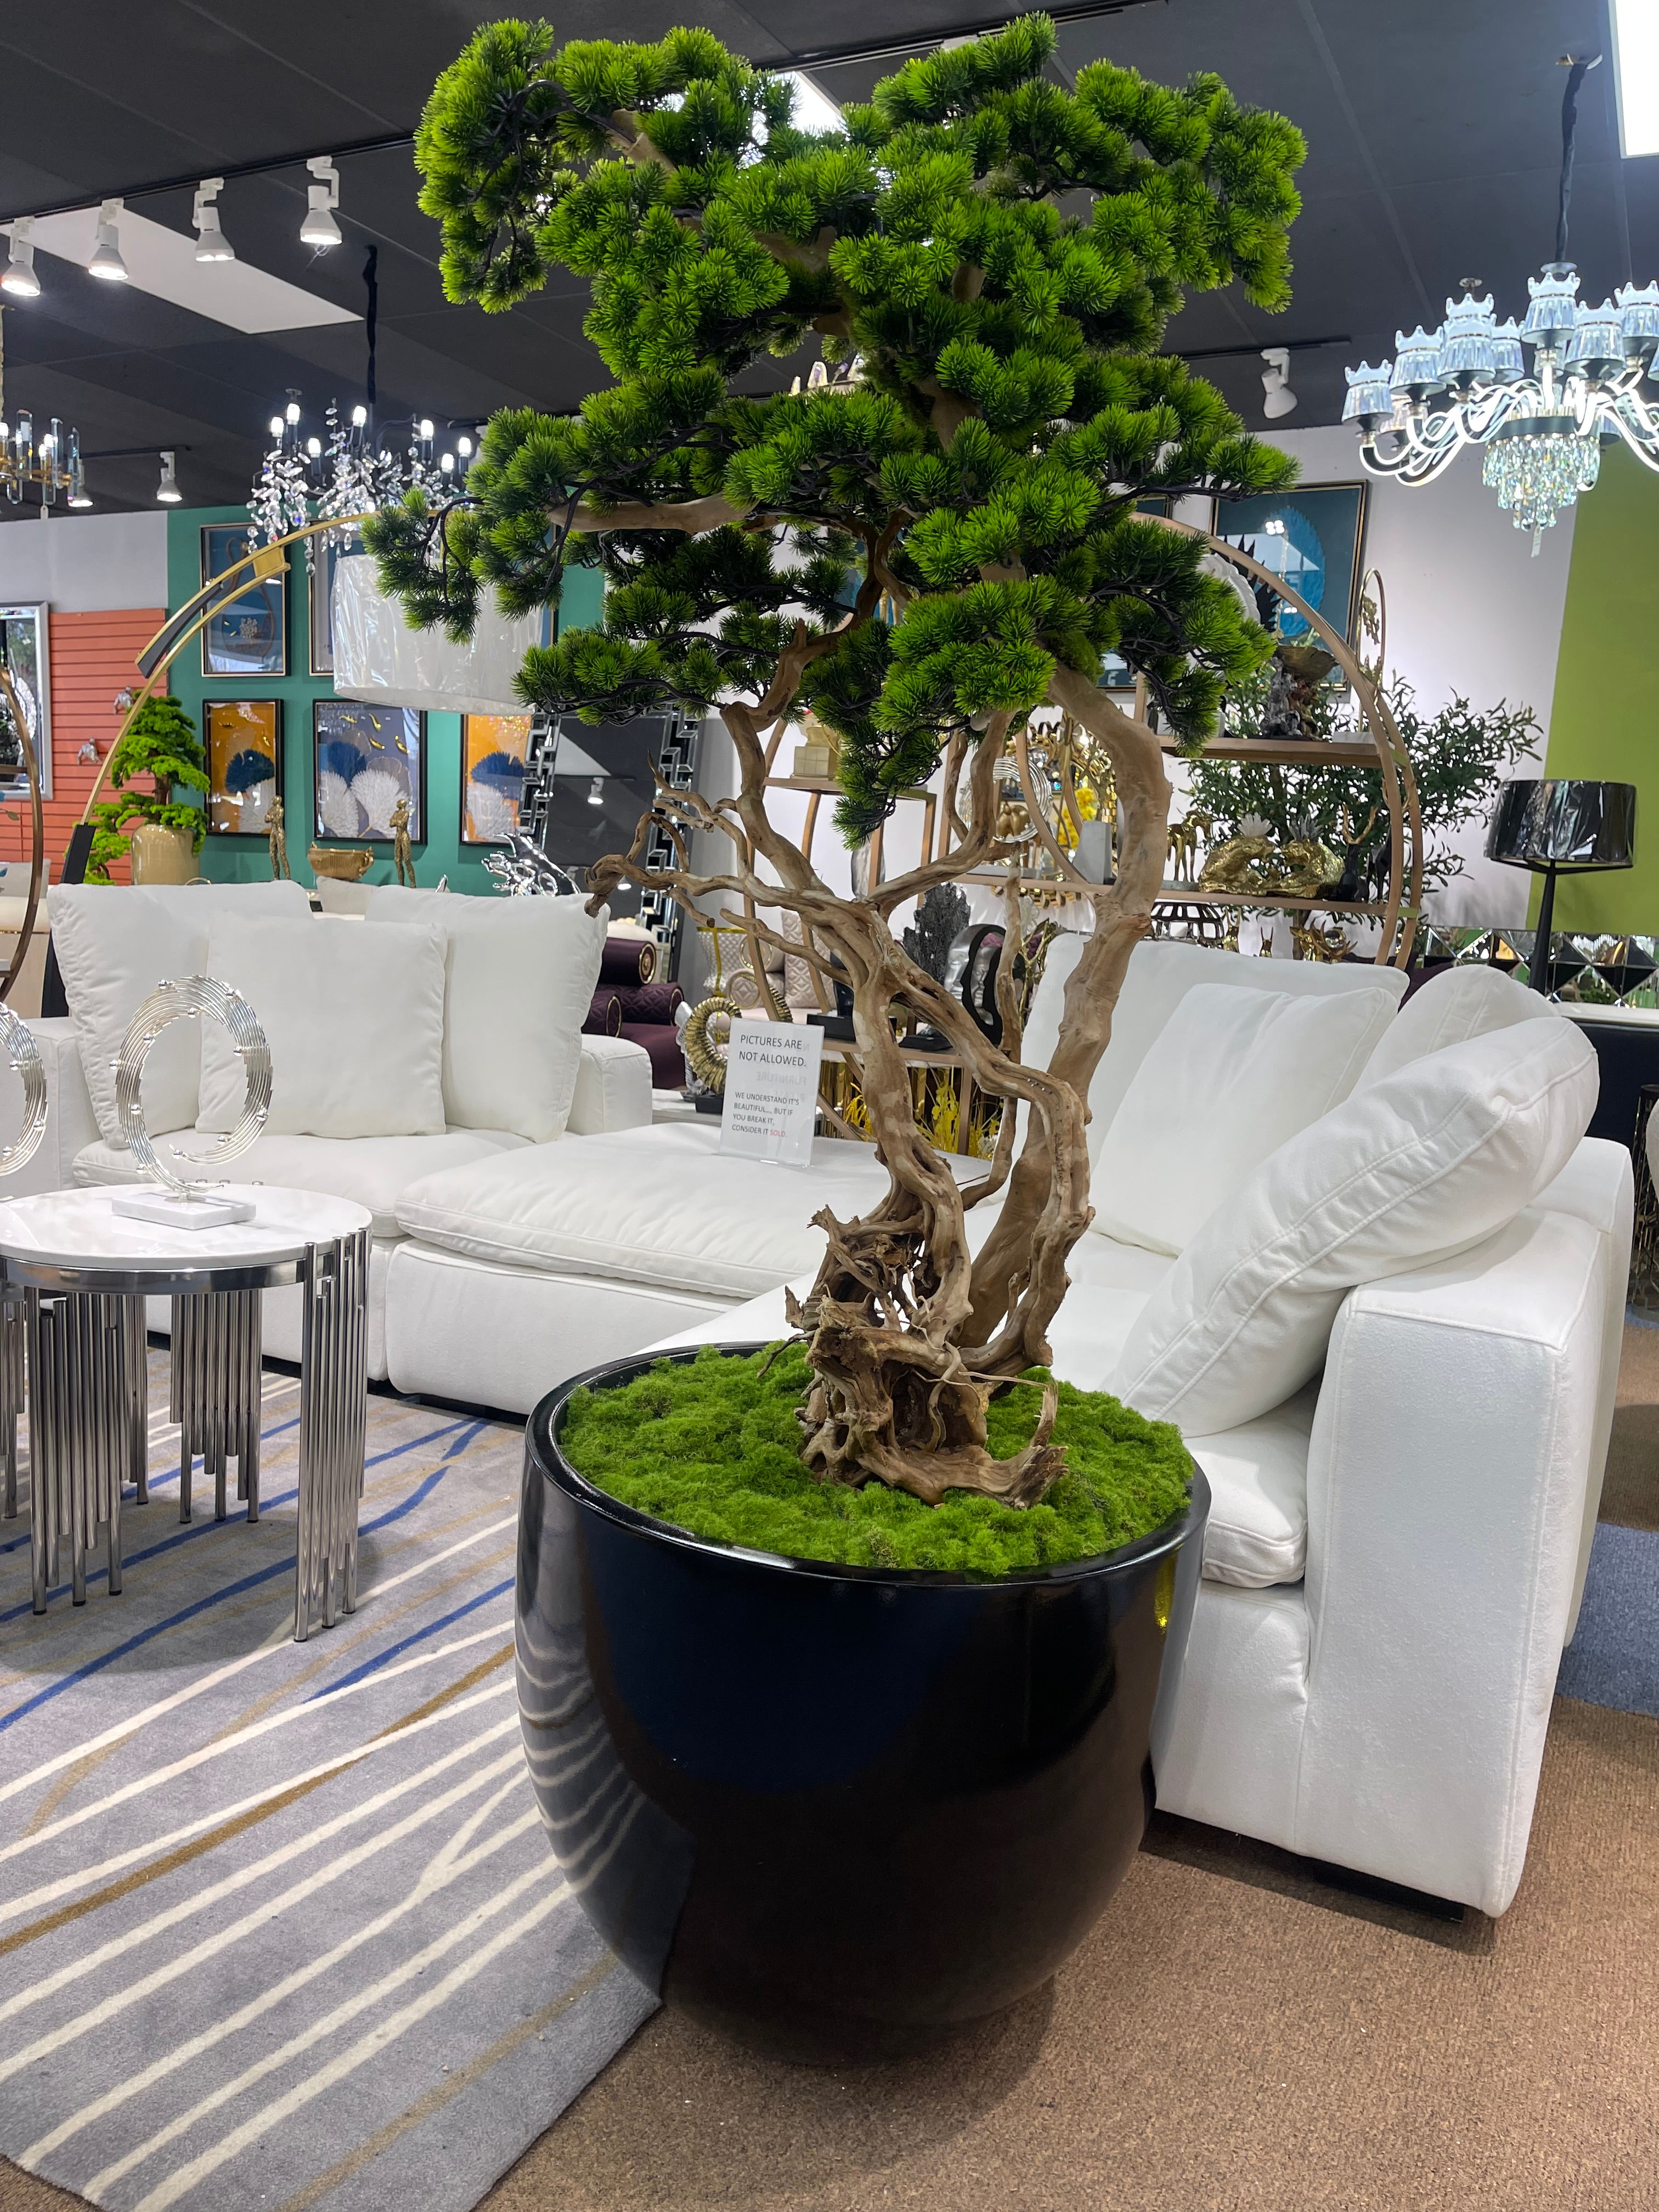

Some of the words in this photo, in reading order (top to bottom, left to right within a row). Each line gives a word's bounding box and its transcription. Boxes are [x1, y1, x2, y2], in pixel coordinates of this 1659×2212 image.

[741, 1035, 782, 1047] PICTURES
[784, 1039, 802, 1049] ARE
[739, 1051, 758, 1061] NOT
[760, 1053, 806, 1066] ALLOWED.
[746, 1093, 787, 1104] UNDERSTAND
[747, 1115, 766, 1124] BREAK
[732, 1124, 761, 1133] CONSIDER
[770, 1129, 787, 1137] SOLD.
